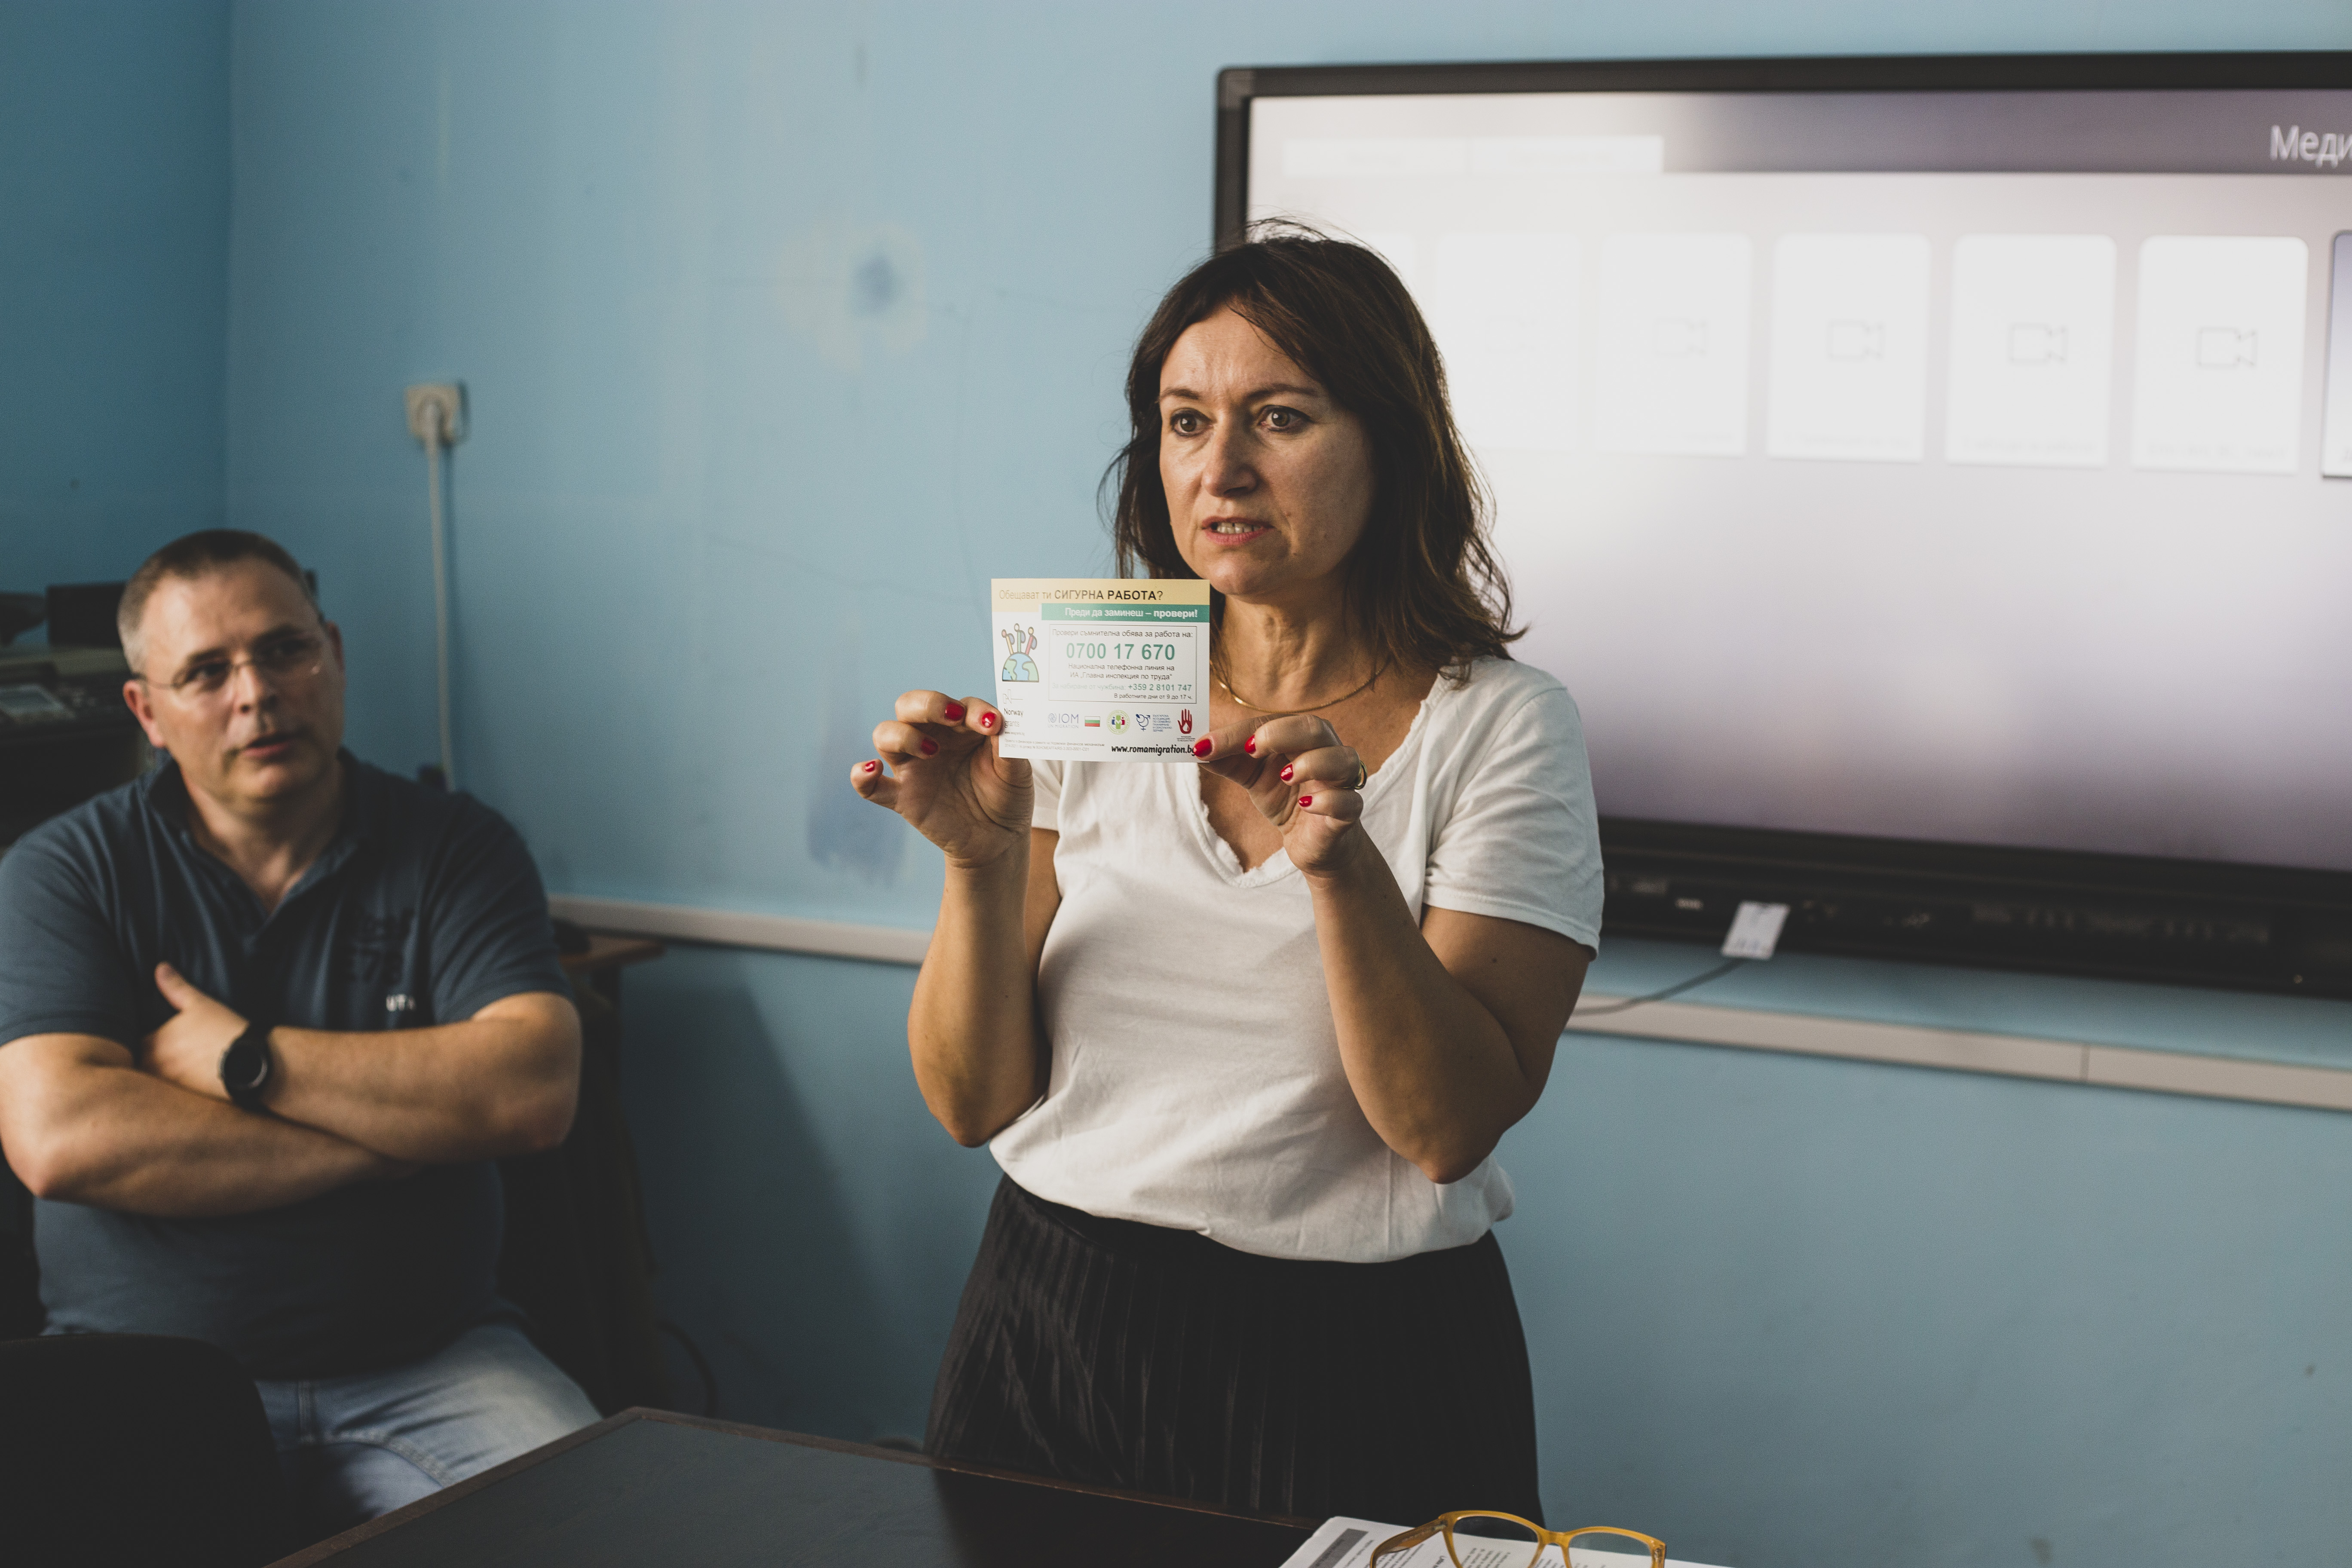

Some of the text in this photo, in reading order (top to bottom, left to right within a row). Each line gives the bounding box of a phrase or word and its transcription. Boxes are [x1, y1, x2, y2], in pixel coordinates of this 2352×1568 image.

[999, 590, 1040, 601] Обещават
[1055, 590, 1104, 600] СИГУРНА
[1107, 590, 1163, 600] РАБОТА?
[1065, 607, 1090, 618] Преди
[1091, 609, 1102, 618] да
[1153, 609, 1198, 619] провери!
[1052, 629, 1078, 637] Провери
[1066, 643, 1175, 660] 0700 17 670
[1004, 707, 1023, 717] Norway
[1059, 713, 1079, 724] IOM
